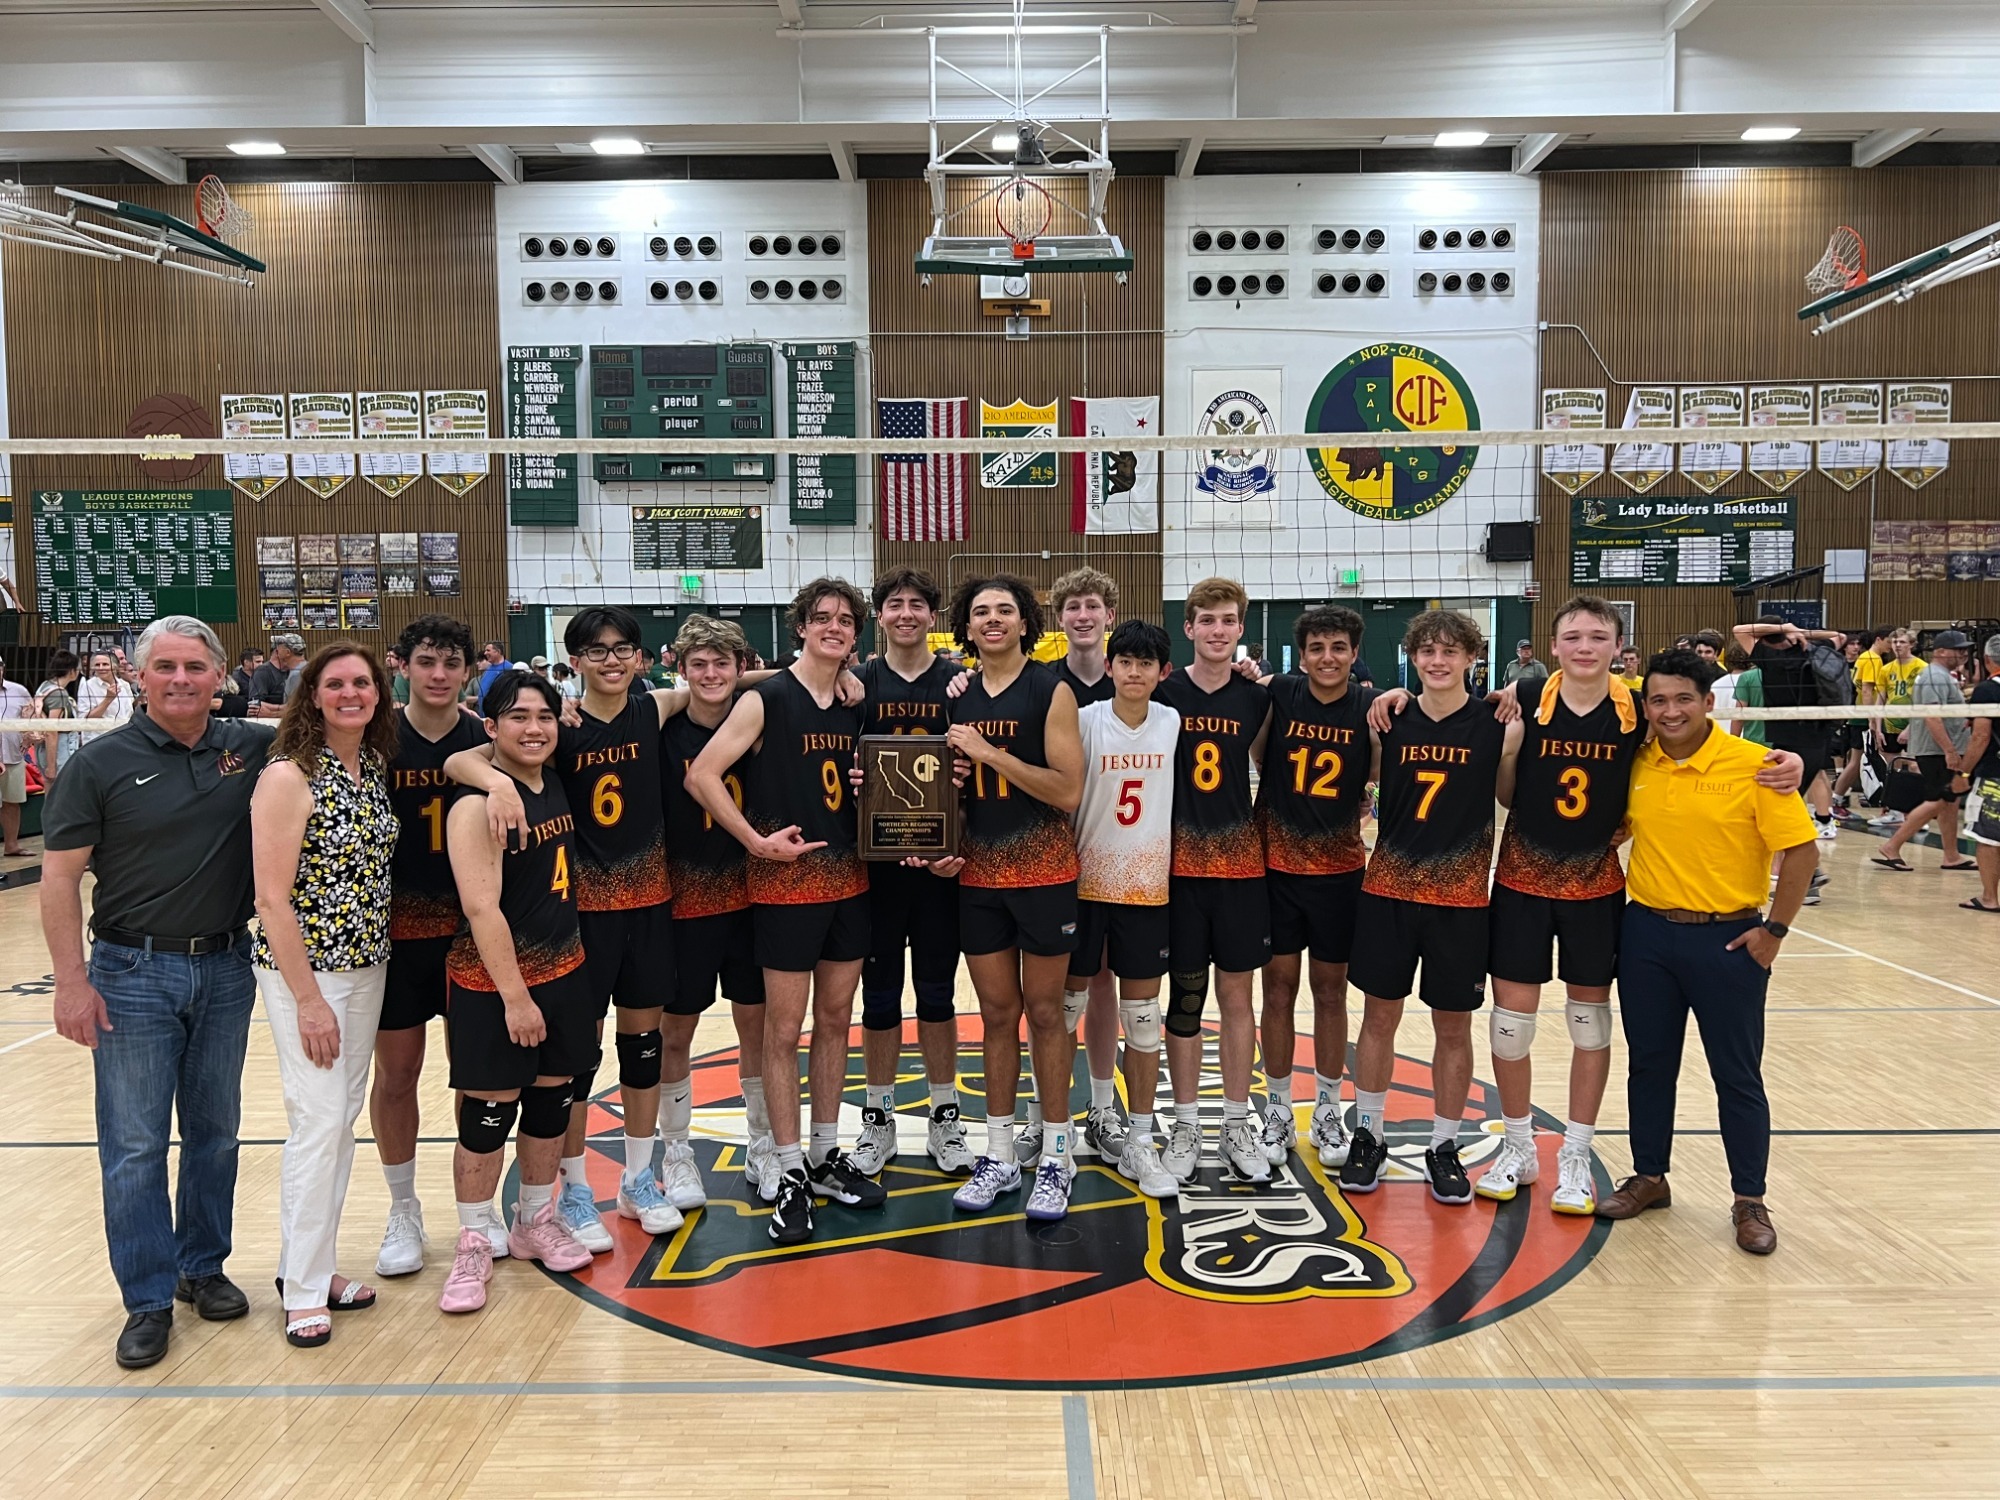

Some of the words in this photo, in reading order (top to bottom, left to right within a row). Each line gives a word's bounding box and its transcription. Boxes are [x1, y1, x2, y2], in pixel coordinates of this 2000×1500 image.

[511, 348, 540, 358] VASITY
[549, 348, 570, 357] BOYS
[728, 351, 763, 362] Guests
[788, 346, 796, 356] JV
[817, 345, 837, 355] BOYS
[1360, 344, 1425, 361] NOR-CAL
[598, 351, 627, 363] Home
[514, 362, 519, 371] 3
[524, 362, 552, 371] ALBERS
[797, 361, 806, 370] AL
[809, 361, 833, 370] RAYES
[514, 373, 519, 382] 4
[524, 373, 558, 382] GARDNER
[797, 372, 821, 381] TRASK
[524, 384, 564, 393] NEWBERRY
[797, 382, 824, 392] FRAZEE
[514, 394, 520, 403] 6
[525, 394, 558, 404] THALKEN
[664, 395, 697, 408] period
[797, 393, 834, 402] THORESON
[1396, 375, 1448, 425] CIF
[515, 405, 520, 414] 7
[525, 405, 548, 414] BURKE
[797, 404, 832, 413] MIKACICH
[514, 416, 520, 425] 8
[525, 416, 556, 425] SANCAK
[797, 414, 826, 424] MERCER
[984, 412, 1000, 420] RIO
[1004, 411, 1055, 420] AMERICANO
[604, 418, 628, 429] fouls
[666, 417, 698, 430] player
[734, 417, 758, 429] fouls
[514, 426, 519, 436] 9
[525, 426, 560, 436] SULLIVAN
[797, 425, 822, 434] WIXOM
[1091, 425, 1099, 469] CARNIA
[1564, 444, 1583, 452] 1977
[986, 428, 1052, 482] RAIDS
[512, 458, 521, 467] 13
[526, 458, 556, 467] MCCARL
[797, 457, 820, 466] COJAN
[511, 469, 522, 478] 15
[798, 468, 821, 476] BURKE
[512, 479, 522, 488] 16
[526, 479, 554, 488] VIDANA
[798, 478, 824, 488] SQUIRE
[1091, 475, 1100, 510] REPUBLIC
[647, 509, 672, 520] JACK
[672, 509, 702, 520] SCOTT
[703, 508, 745, 519] TOURNEY
[1619, 504, 1652, 518] Lady
[1656, 503, 1709, 515] Raiders
[1713, 502, 1788, 515] Basketball
[1894, 680, 1906, 696] 18
[878, 703, 940, 721] JESUIT
[963, 721, 1018, 737] SUIT
[1286, 720, 1354, 744] JESUIT
[803, 734, 852, 755] JESUIT
[1540, 739, 1618, 760] JESUIT
[574, 743, 639, 772] JESUIT
[1400, 745, 1470, 765] JESUIT
[913, 754, 940, 782] CIF
[1100, 754, 1164, 775] JESUIT
[1191, 740, 1222, 794] 8
[1288, 745, 1344, 800] 12
[395, 770, 458, 790] JESU
[822, 760, 842, 812] 9
[1694, 780, 1734, 792] JESUIT
[1414, 770, 1448, 822] 7
[1554, 766, 1590, 819] 3
[592, 772, 624, 827] 6
[1114, 778, 1146, 828] 5
[534, 814, 574, 848] JESUIT
[551, 844, 571, 902] 4
